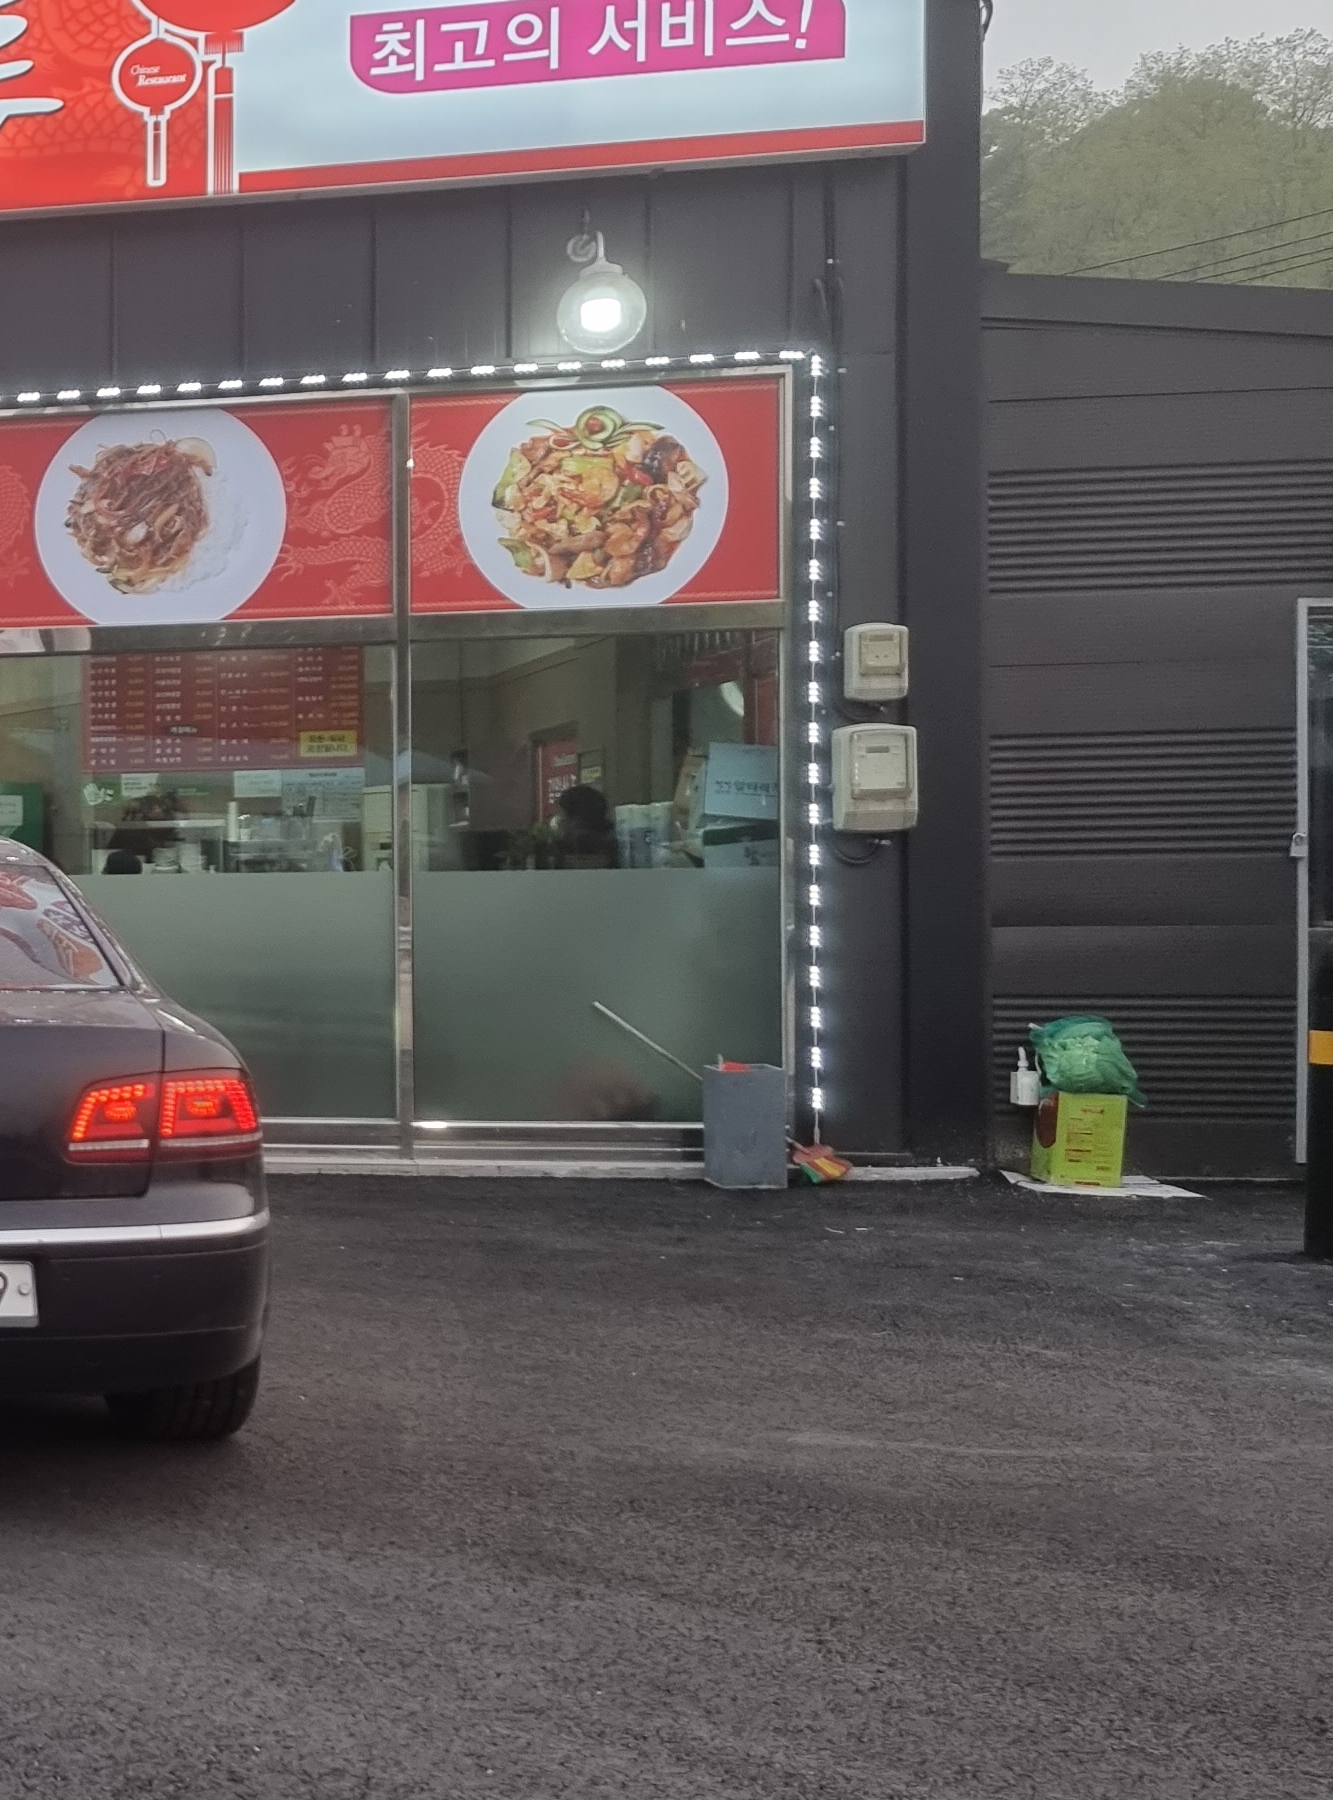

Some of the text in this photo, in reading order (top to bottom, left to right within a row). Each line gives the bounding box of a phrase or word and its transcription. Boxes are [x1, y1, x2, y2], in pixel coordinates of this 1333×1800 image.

[369, 0, 813, 81] 최고의 서비스!
[136, 74, 187, 86] Restaurant
